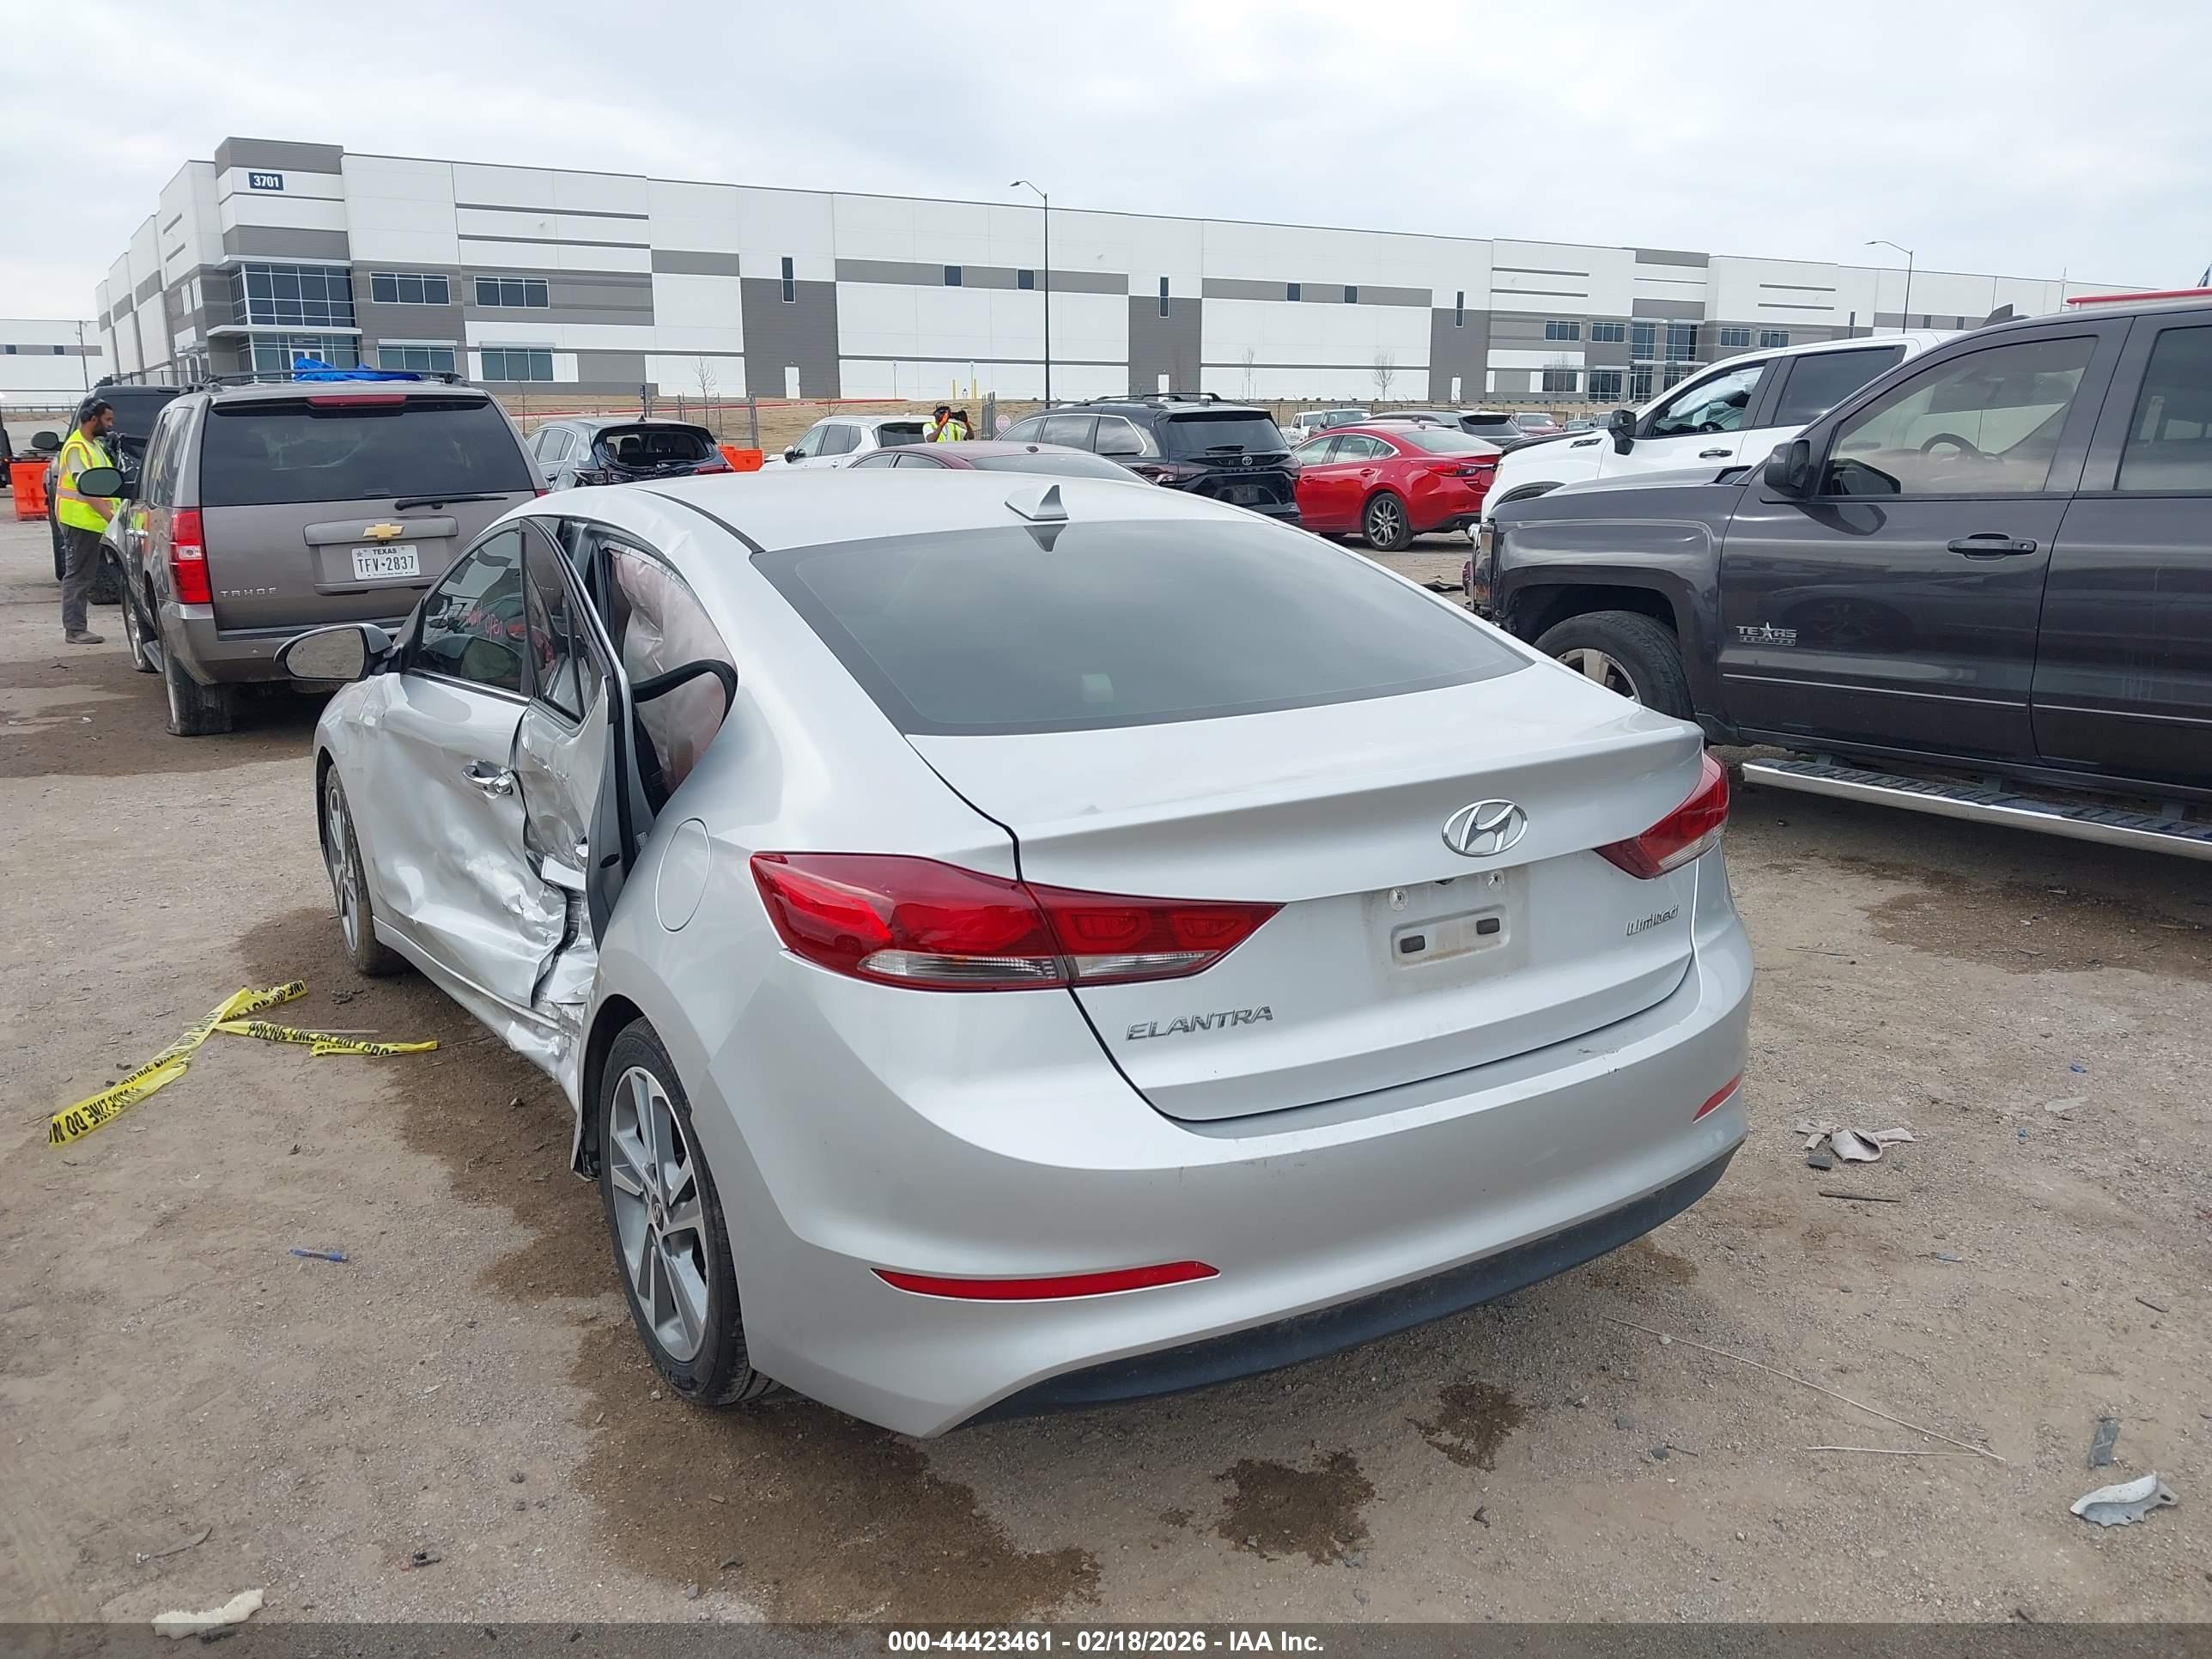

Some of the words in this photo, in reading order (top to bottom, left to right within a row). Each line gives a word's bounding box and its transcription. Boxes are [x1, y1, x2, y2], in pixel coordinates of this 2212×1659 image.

[253, 174, 279, 188] 3701
[220, 587, 276, 598] TAHOE
[1626, 903, 1679, 936] Limited
[1126, 1004, 1273, 1040] ELANTRA
